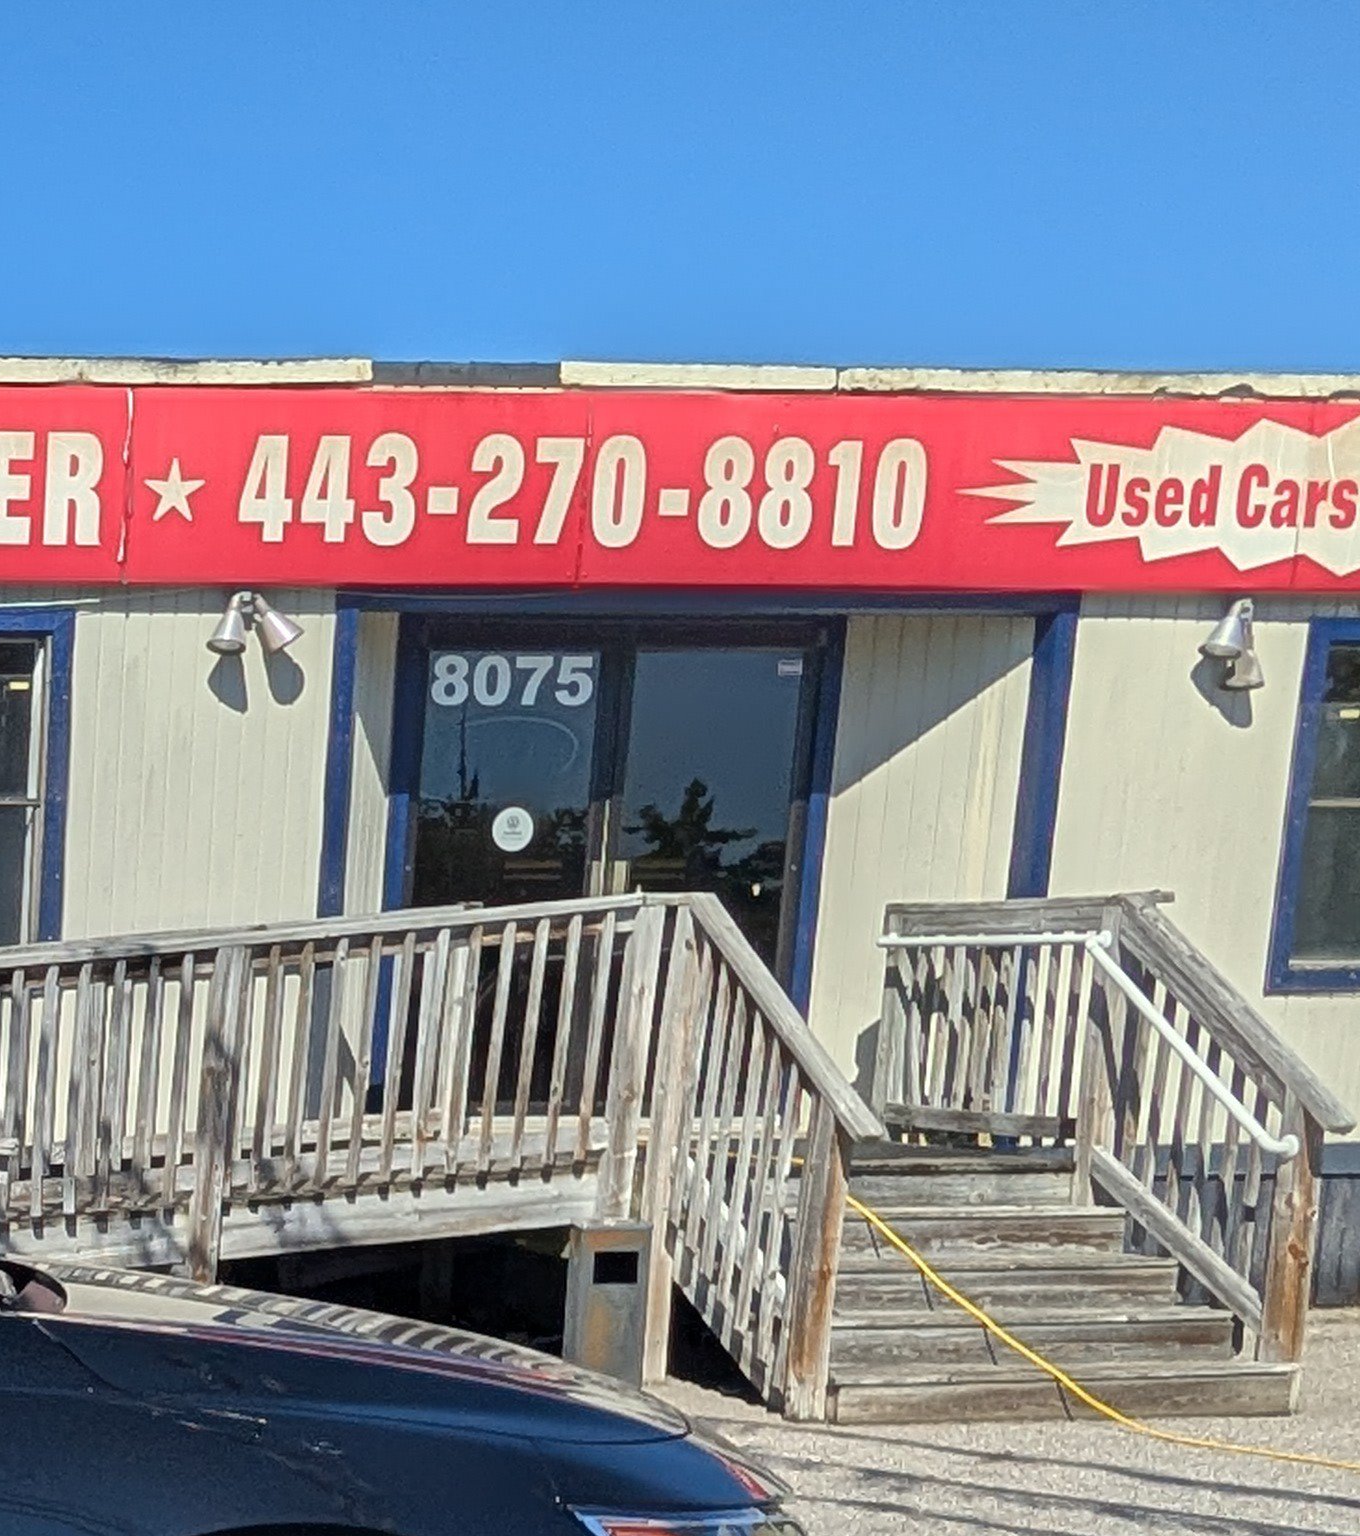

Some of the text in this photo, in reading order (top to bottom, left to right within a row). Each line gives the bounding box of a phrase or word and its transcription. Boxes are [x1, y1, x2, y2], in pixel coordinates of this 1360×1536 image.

[237, 432, 929, 550] 443-270-8810
[1085, 462, 1360, 530] Used Cars
[430, 654, 594, 707] 8075
